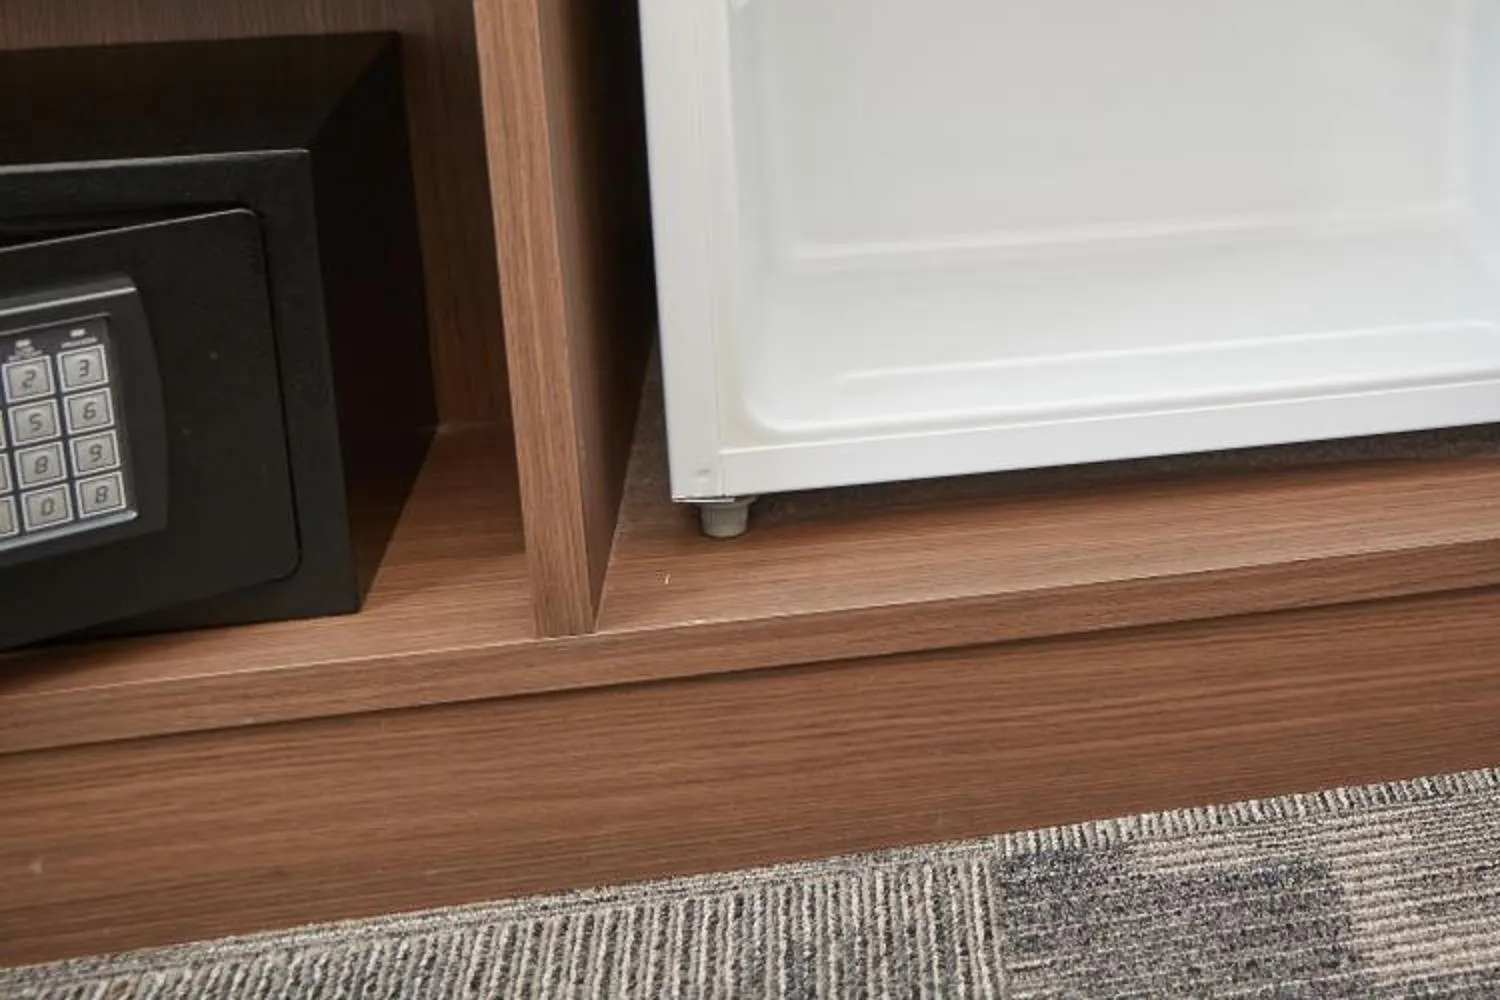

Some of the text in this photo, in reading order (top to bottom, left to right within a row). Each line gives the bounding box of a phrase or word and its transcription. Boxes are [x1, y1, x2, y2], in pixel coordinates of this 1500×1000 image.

[79, 359, 90, 378] 3
[22, 369, 37, 389] 2
[83, 401, 97, 421] 6
[28, 412, 44, 432] 5
[89, 443, 103, 462] 9
